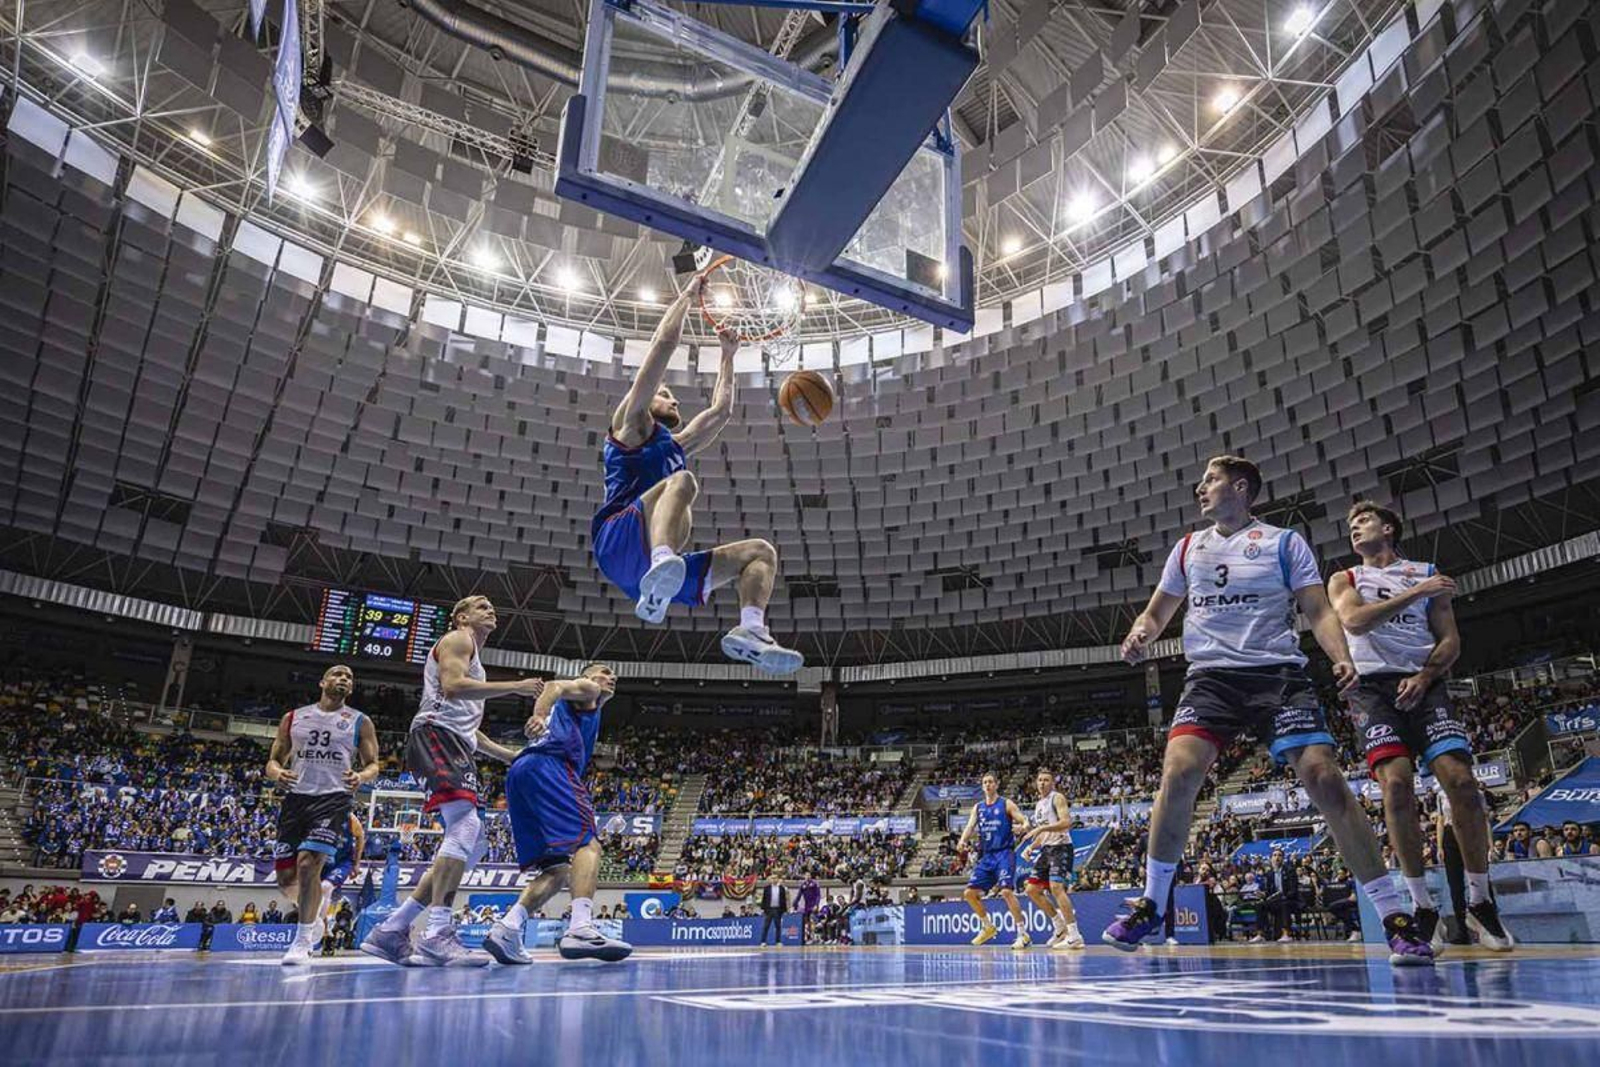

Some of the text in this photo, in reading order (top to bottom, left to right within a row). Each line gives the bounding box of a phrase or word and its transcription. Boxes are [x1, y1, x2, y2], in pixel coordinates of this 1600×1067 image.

[1214, 564, 1228, 588] 3
[1193, 594, 1259, 607] UEMC
[365, 609, 410, 625] 39 25
[364, 643, 392, 657] 49.0
[308, 730, 332, 747] 33
[297, 750, 343, 761] UEMC
[141, 857, 255, 882] PEÑA
[1174, 906, 1198, 926] blo
[2, 928, 65, 944] TOS
